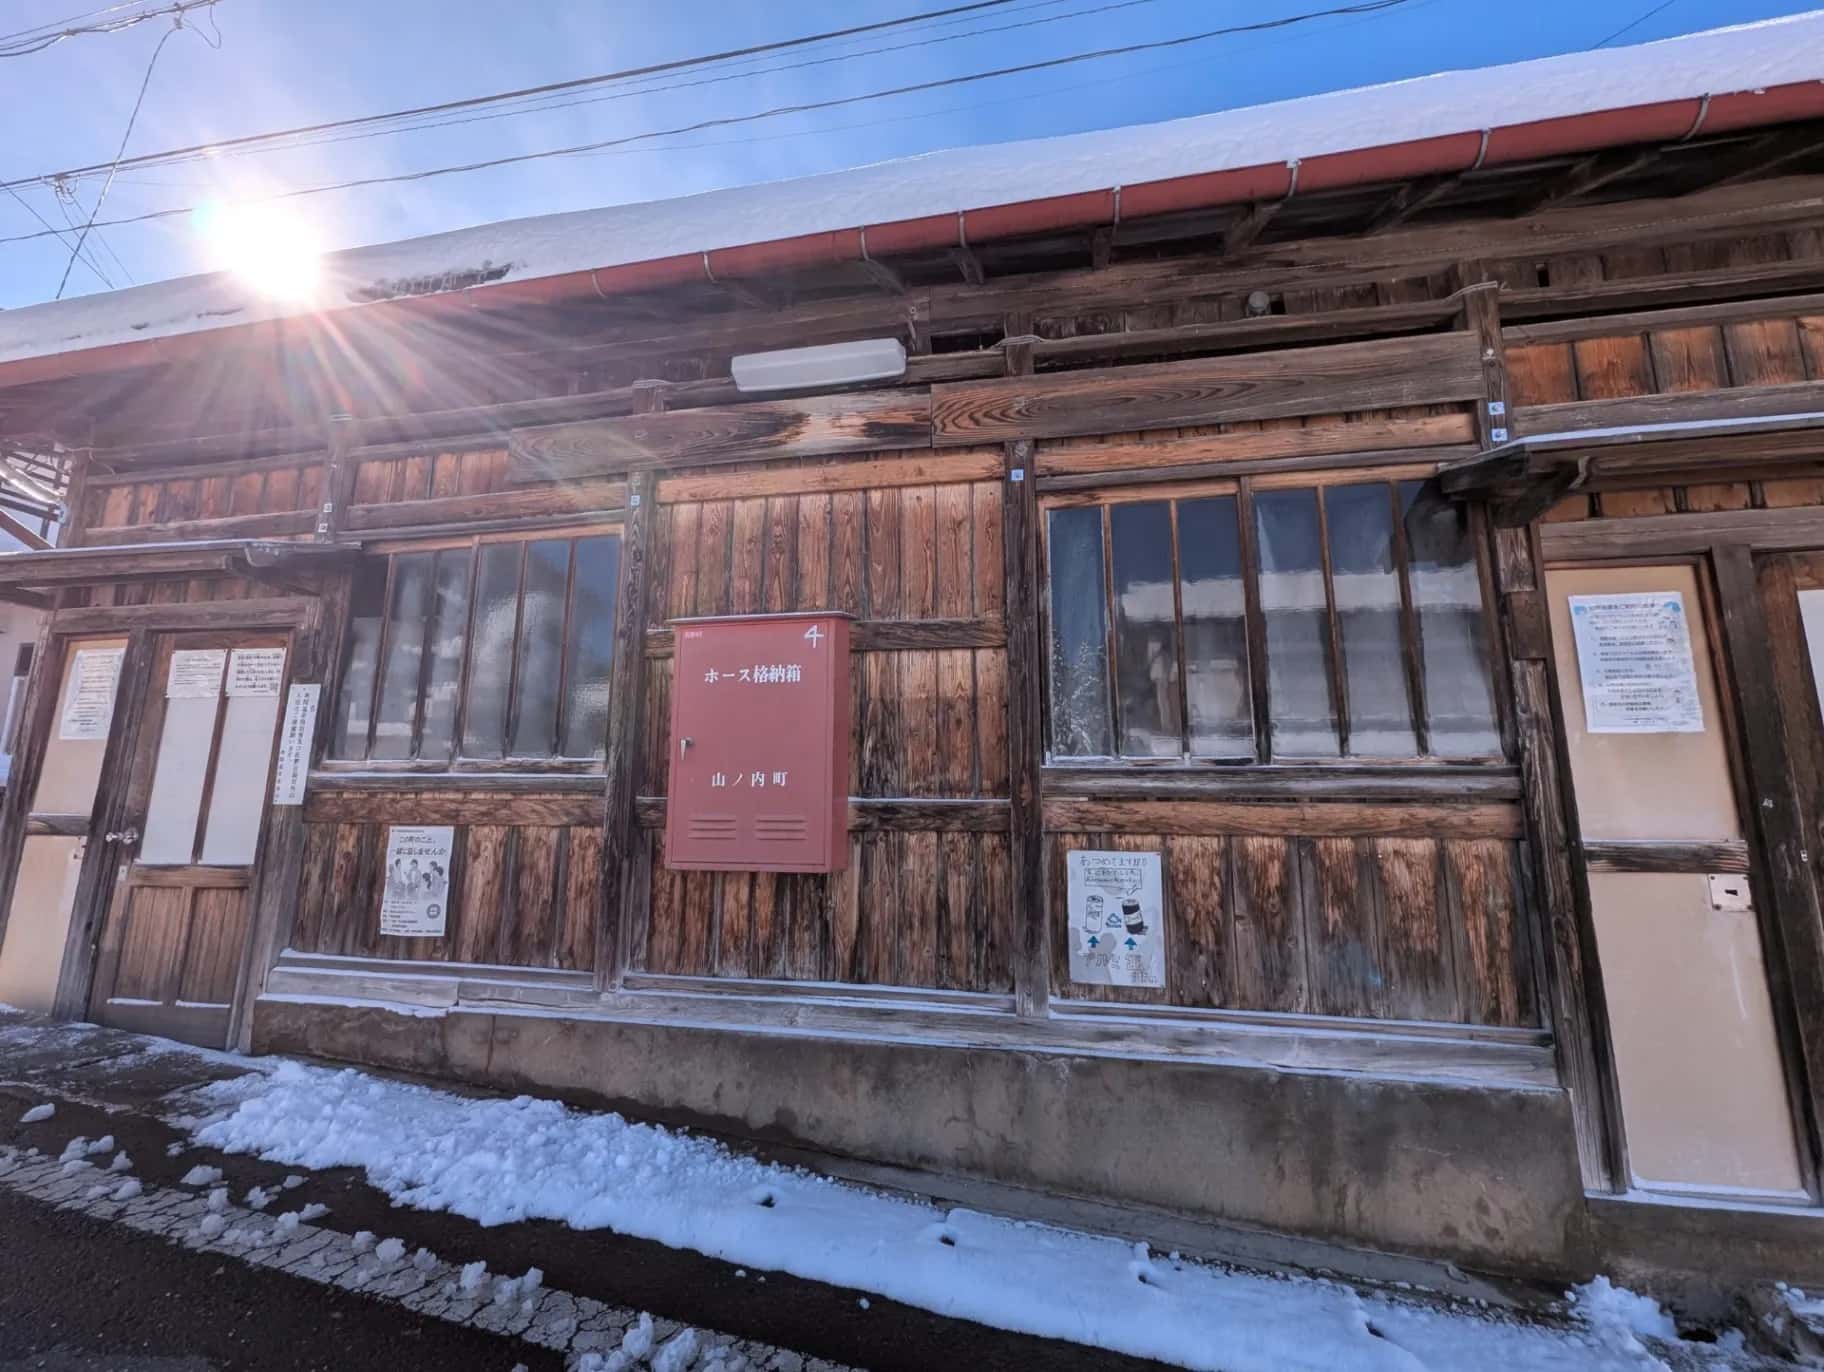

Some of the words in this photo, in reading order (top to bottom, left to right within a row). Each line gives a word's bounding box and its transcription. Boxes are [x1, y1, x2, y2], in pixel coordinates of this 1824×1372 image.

[804, 624, 824, 648] 4
[704, 664, 802, 683] ホース格納箱
[712, 771, 789, 787] 山ノ内町
